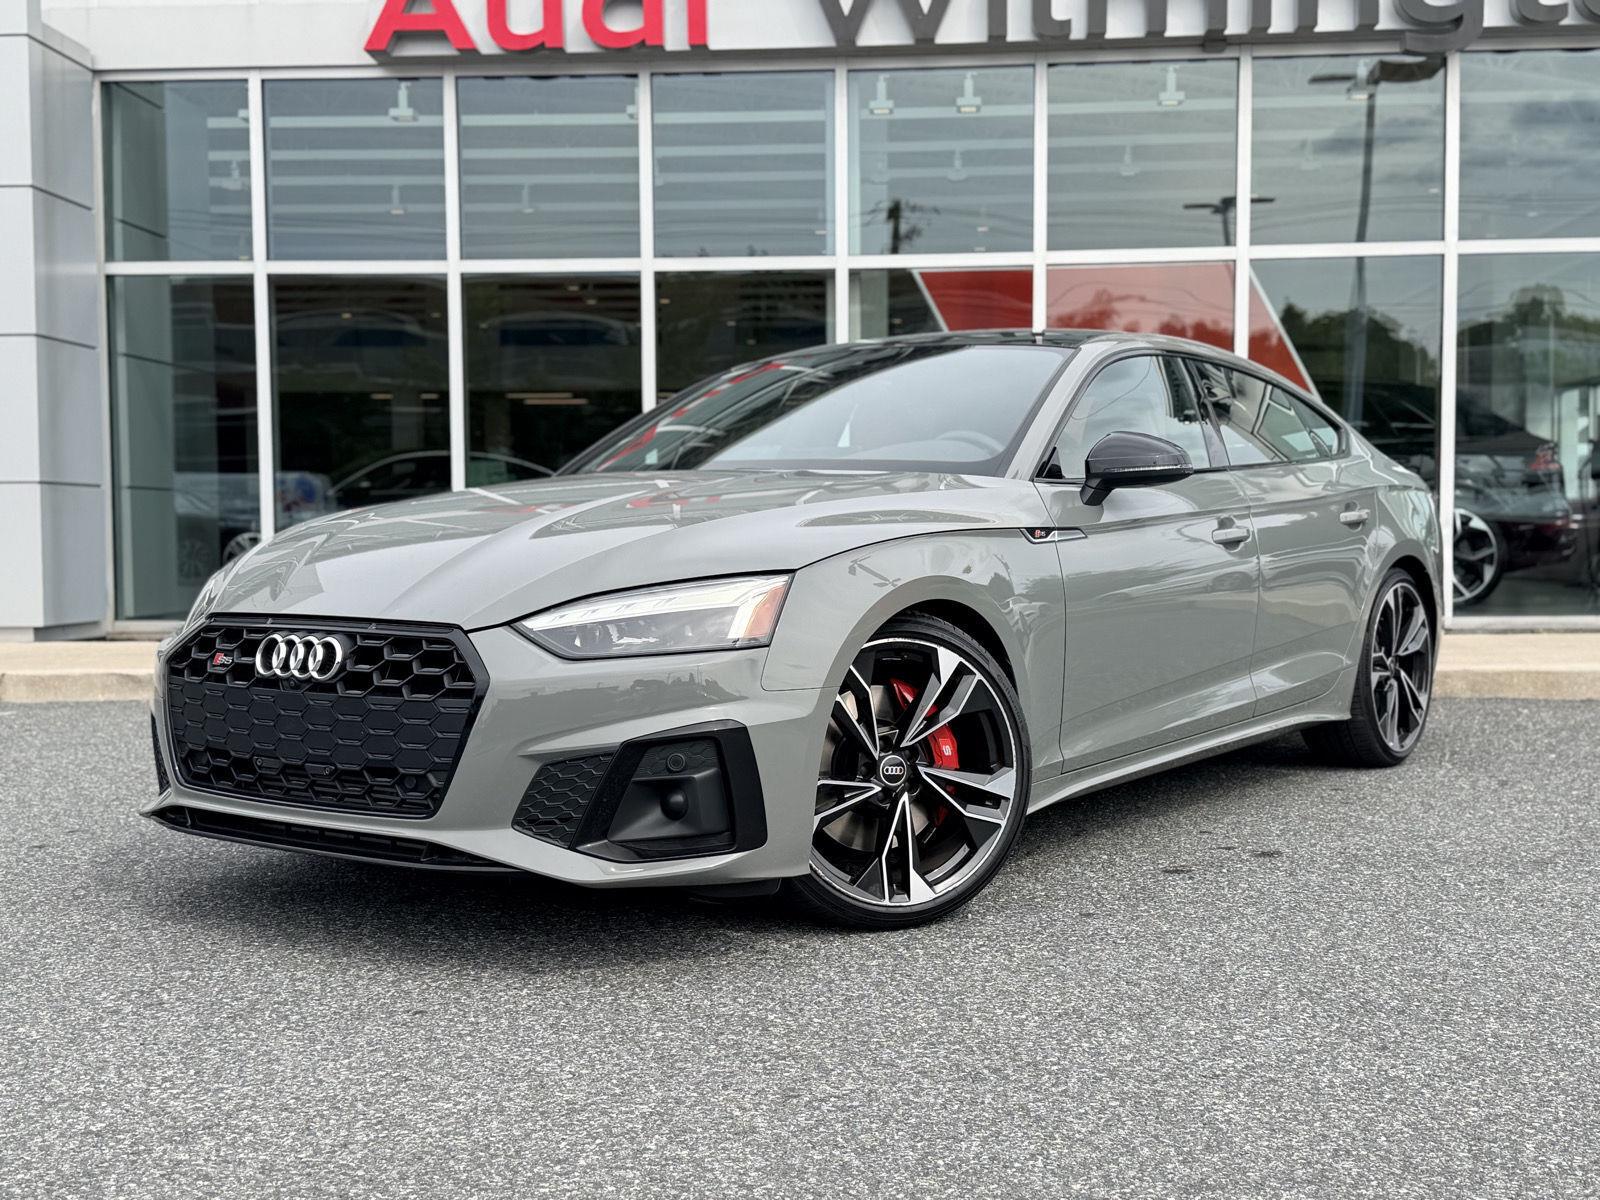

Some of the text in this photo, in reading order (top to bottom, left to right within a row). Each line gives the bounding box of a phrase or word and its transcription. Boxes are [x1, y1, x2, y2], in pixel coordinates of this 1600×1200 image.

[364, 0, 1600, 52] Audi Wilmingt
[942, 744, 952, 756] S
